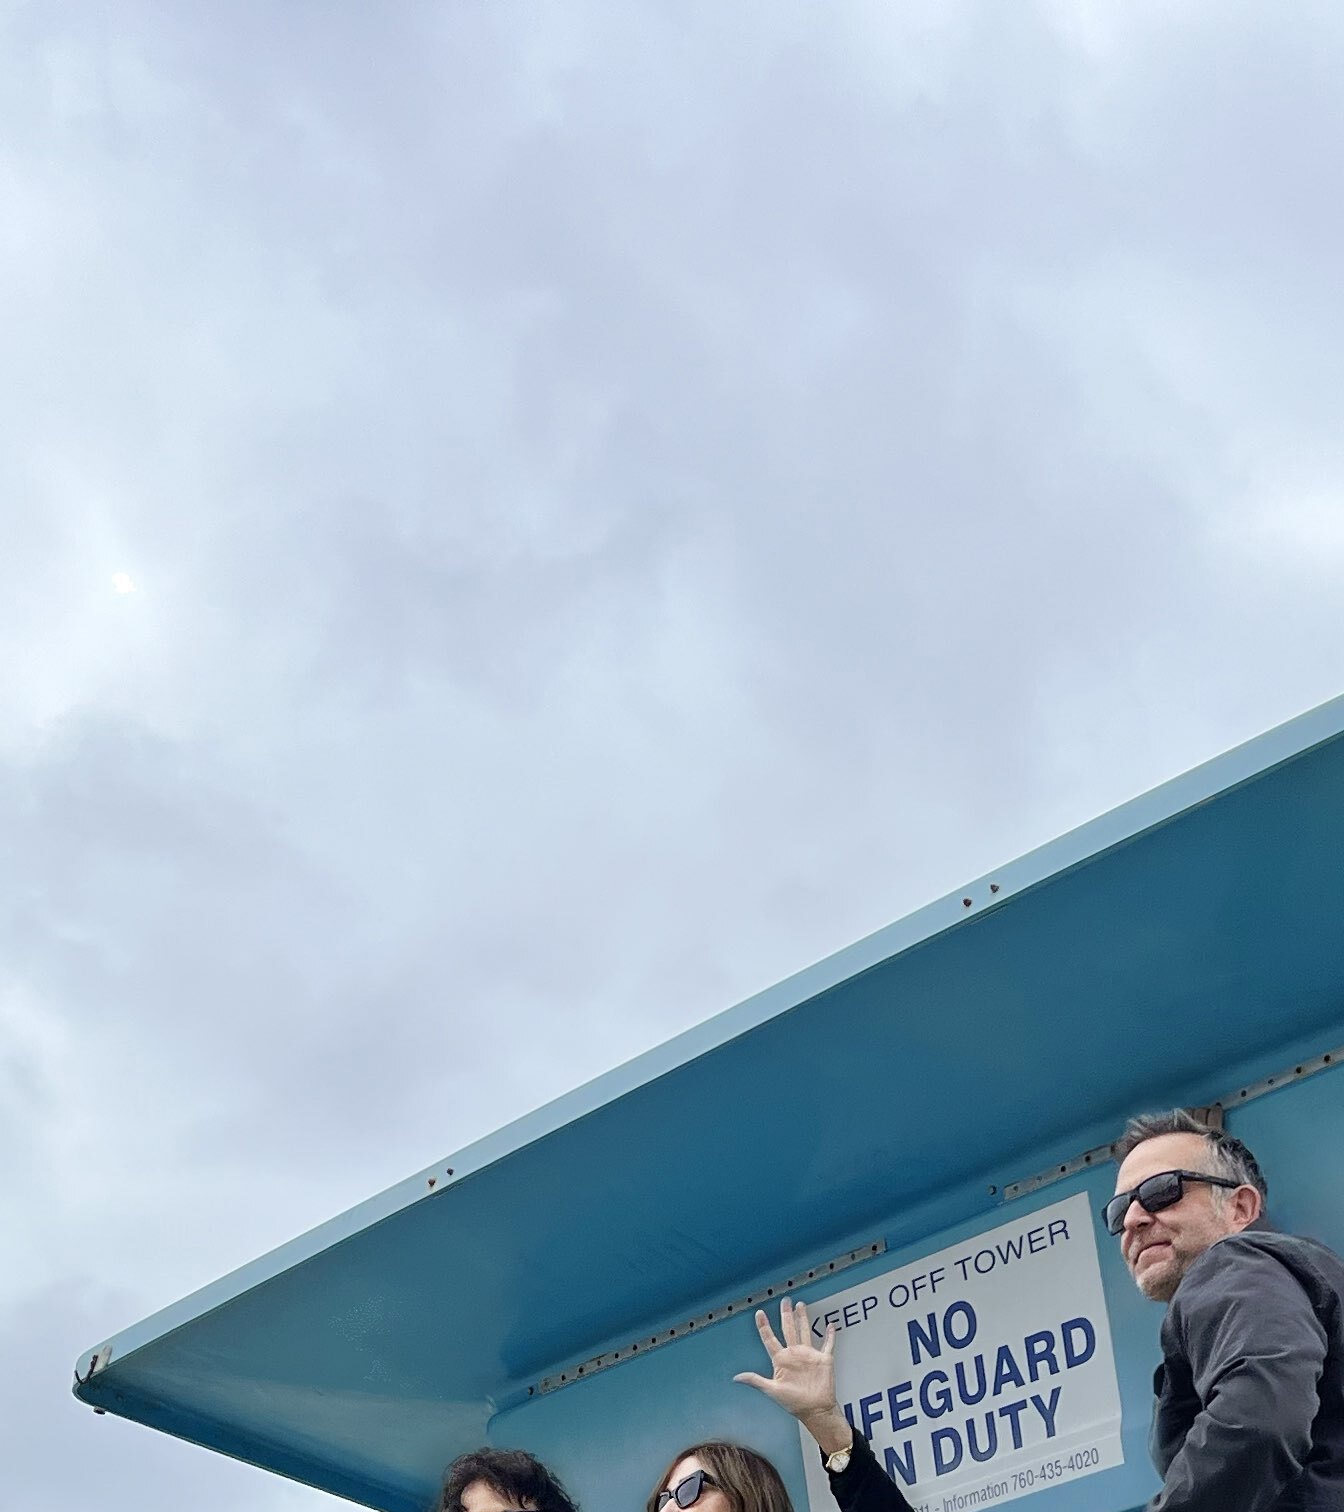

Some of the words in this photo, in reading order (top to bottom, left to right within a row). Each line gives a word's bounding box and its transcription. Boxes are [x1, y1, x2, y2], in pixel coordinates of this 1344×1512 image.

[888, 1267, 946, 1308] OFF
[953, 1219, 1071, 1281] TOWER
[906, 1300, 978, 1366] NO
[843, 1316, 1096, 1441] IFEGUARD
[883, 1440, 918, 1487] N
[930, 1385, 1063, 1478] DUTY
[1010, 1447, 1100, 1492] 760-435-4020
